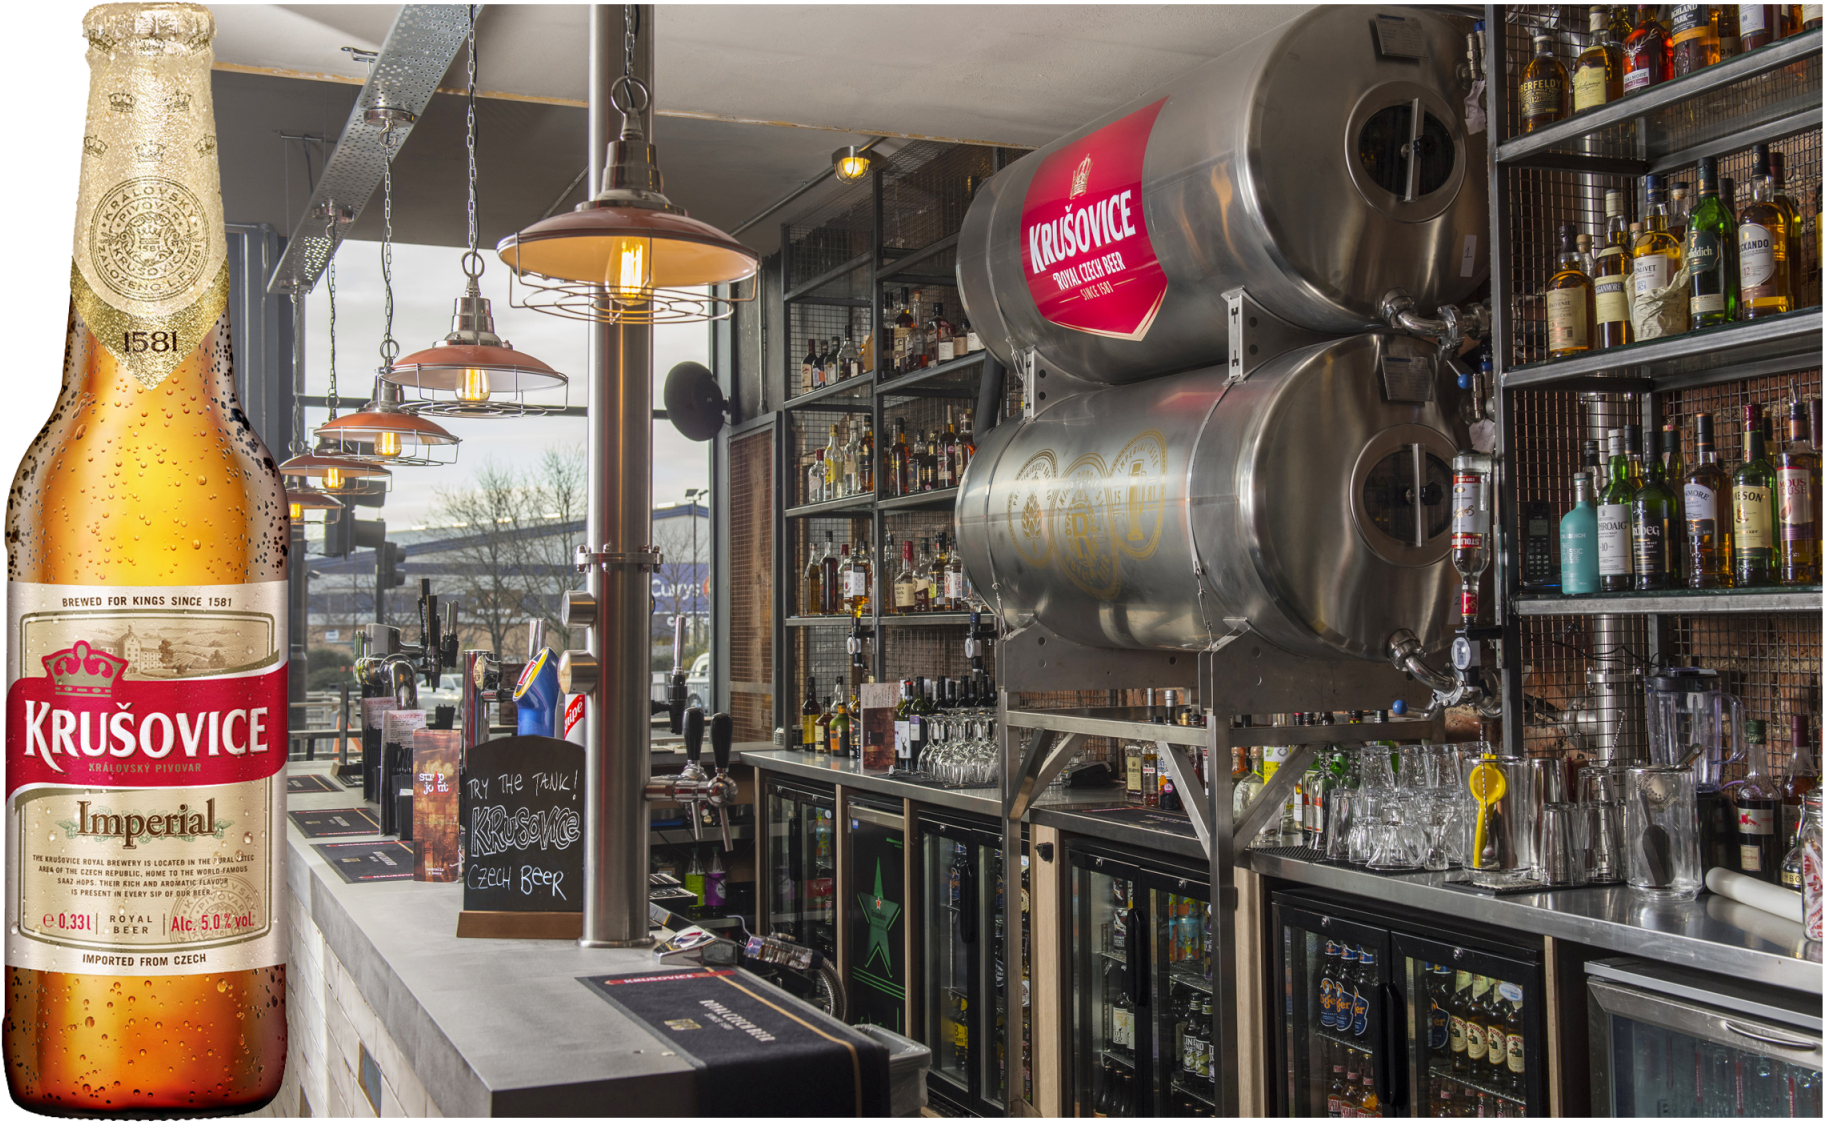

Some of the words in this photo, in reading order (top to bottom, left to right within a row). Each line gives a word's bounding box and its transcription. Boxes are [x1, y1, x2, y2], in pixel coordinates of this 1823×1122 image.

[1673, 13, 1688, 25] PARK
[1520, 79, 1562, 93] BERFELDY
[1028, 189, 1136, 275] KRUŠOVICE
[1053, 266, 1082, 291] ROYAL
[1079, 258, 1106, 282] CZECH
[1101, 251, 1127, 275] BEER
[1743, 266, 1751, 276] 12
[1080, 285, 1100, 301] SINCE
[1097, 280, 1114, 296] 1581
[123, 331, 178, 353] 1581
[1117, 442, 1148, 474] IMPERIAL
[1146, 443, 1159, 468] TASTE
[1113, 490, 1122, 507] 15
[1147, 485, 1156, 502] 81
[1601, 542, 1608, 552] 10
[62, 597, 102, 607] BREWED
[107, 596, 128, 607] FOR
[132, 596, 166, 606] KINGS
[171, 596, 202, 607] SINCE
[208, 597, 233, 607] 1581
[24, 700, 269, 774] KRUŠOVICE
[89, 761, 151, 773] KRÁLOVSKÝ
[156, 762, 202, 773] PIVOVAR
[467, 778, 489, 799] TRY
[76, 797, 217, 850] Imperial
[32, 854, 43, 862] THE
[45, 856, 80, 865] KRUŠOVICE
[83, 858, 104, 866] ROYAL
[107, 859, 141, 867] BREWERY
[154, 859, 185, 867] LOCATED
[197, 865, 248, 875] WORLD-FAMOUS
[58, 877, 73, 885] SAAZ
[161, 879, 196, 887] AROMATIC
[199, 878, 228, 886] FLAVOUR
[81, 889, 111, 897] PRESENT
[125, 890, 147, 898] EVERY
[193, 889, 213, 897] BEER.
[109, 914, 153, 923] ROYAL
[171, 916, 196, 932] Alc.
[235, 911, 255, 927] vol.
[113, 926, 149, 934] BEER
[82, 953, 135, 967] IMPORTED
[140, 955, 168, 967] FROM
[174, 953, 206, 965] CZECH
[722, 1013, 757, 1030] CZECH
[745, 1028, 776, 1042] BEER
